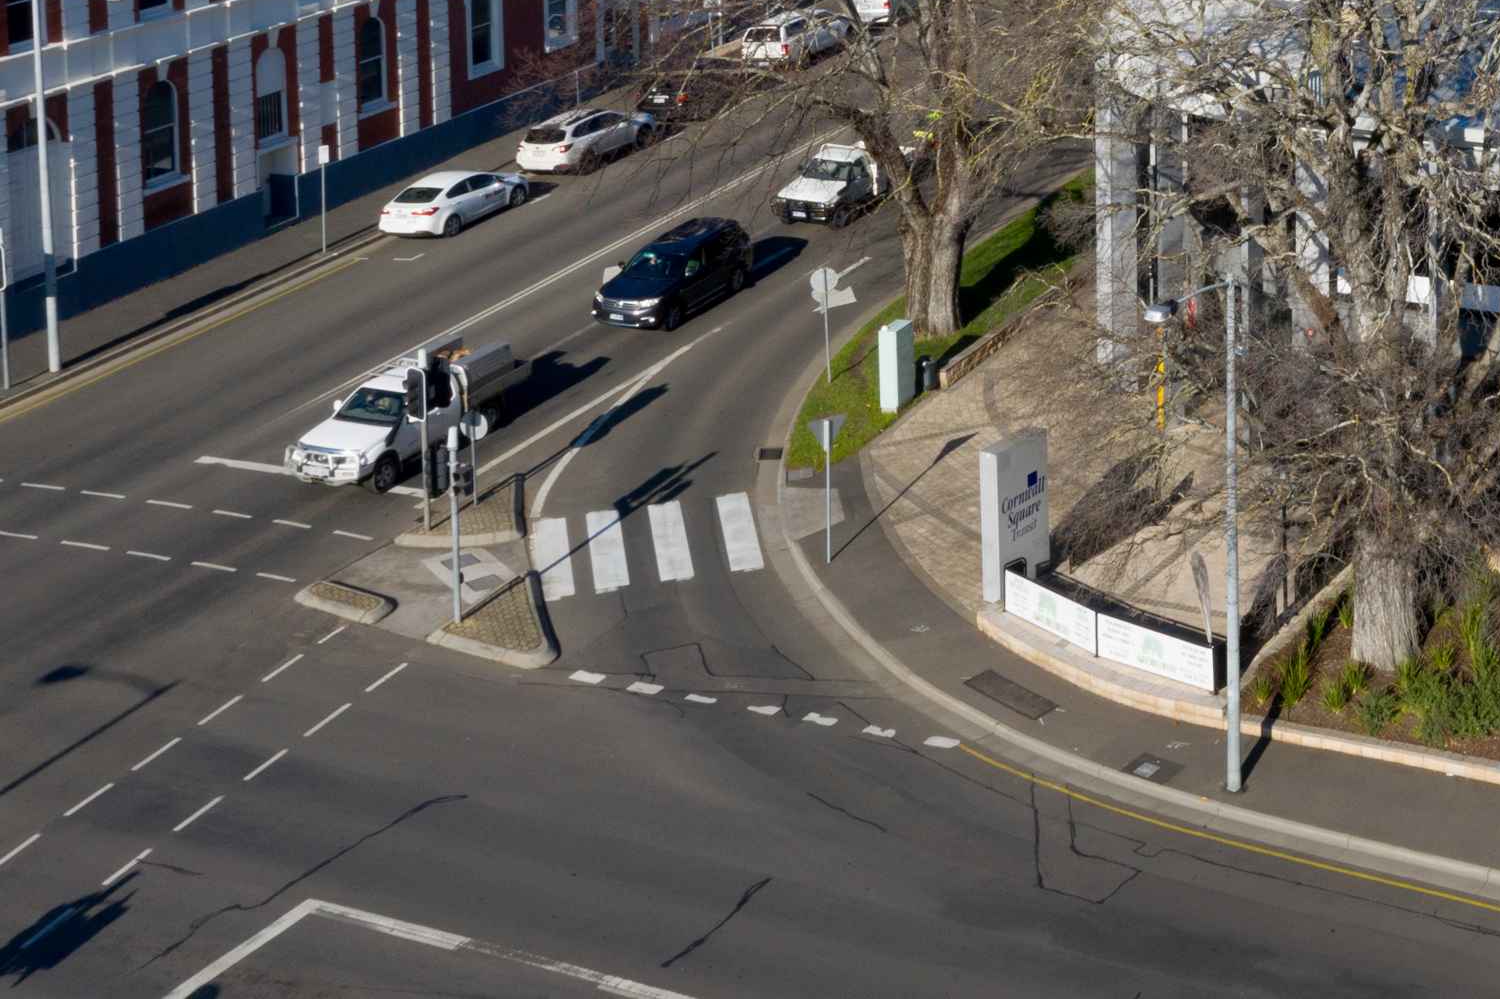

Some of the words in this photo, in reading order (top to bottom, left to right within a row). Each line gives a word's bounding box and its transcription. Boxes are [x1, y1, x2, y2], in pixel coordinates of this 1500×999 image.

[1001, 475, 1046, 515] Cornwall
[1007, 499, 1042, 530] Square
[1011, 517, 1038, 542] Transit
